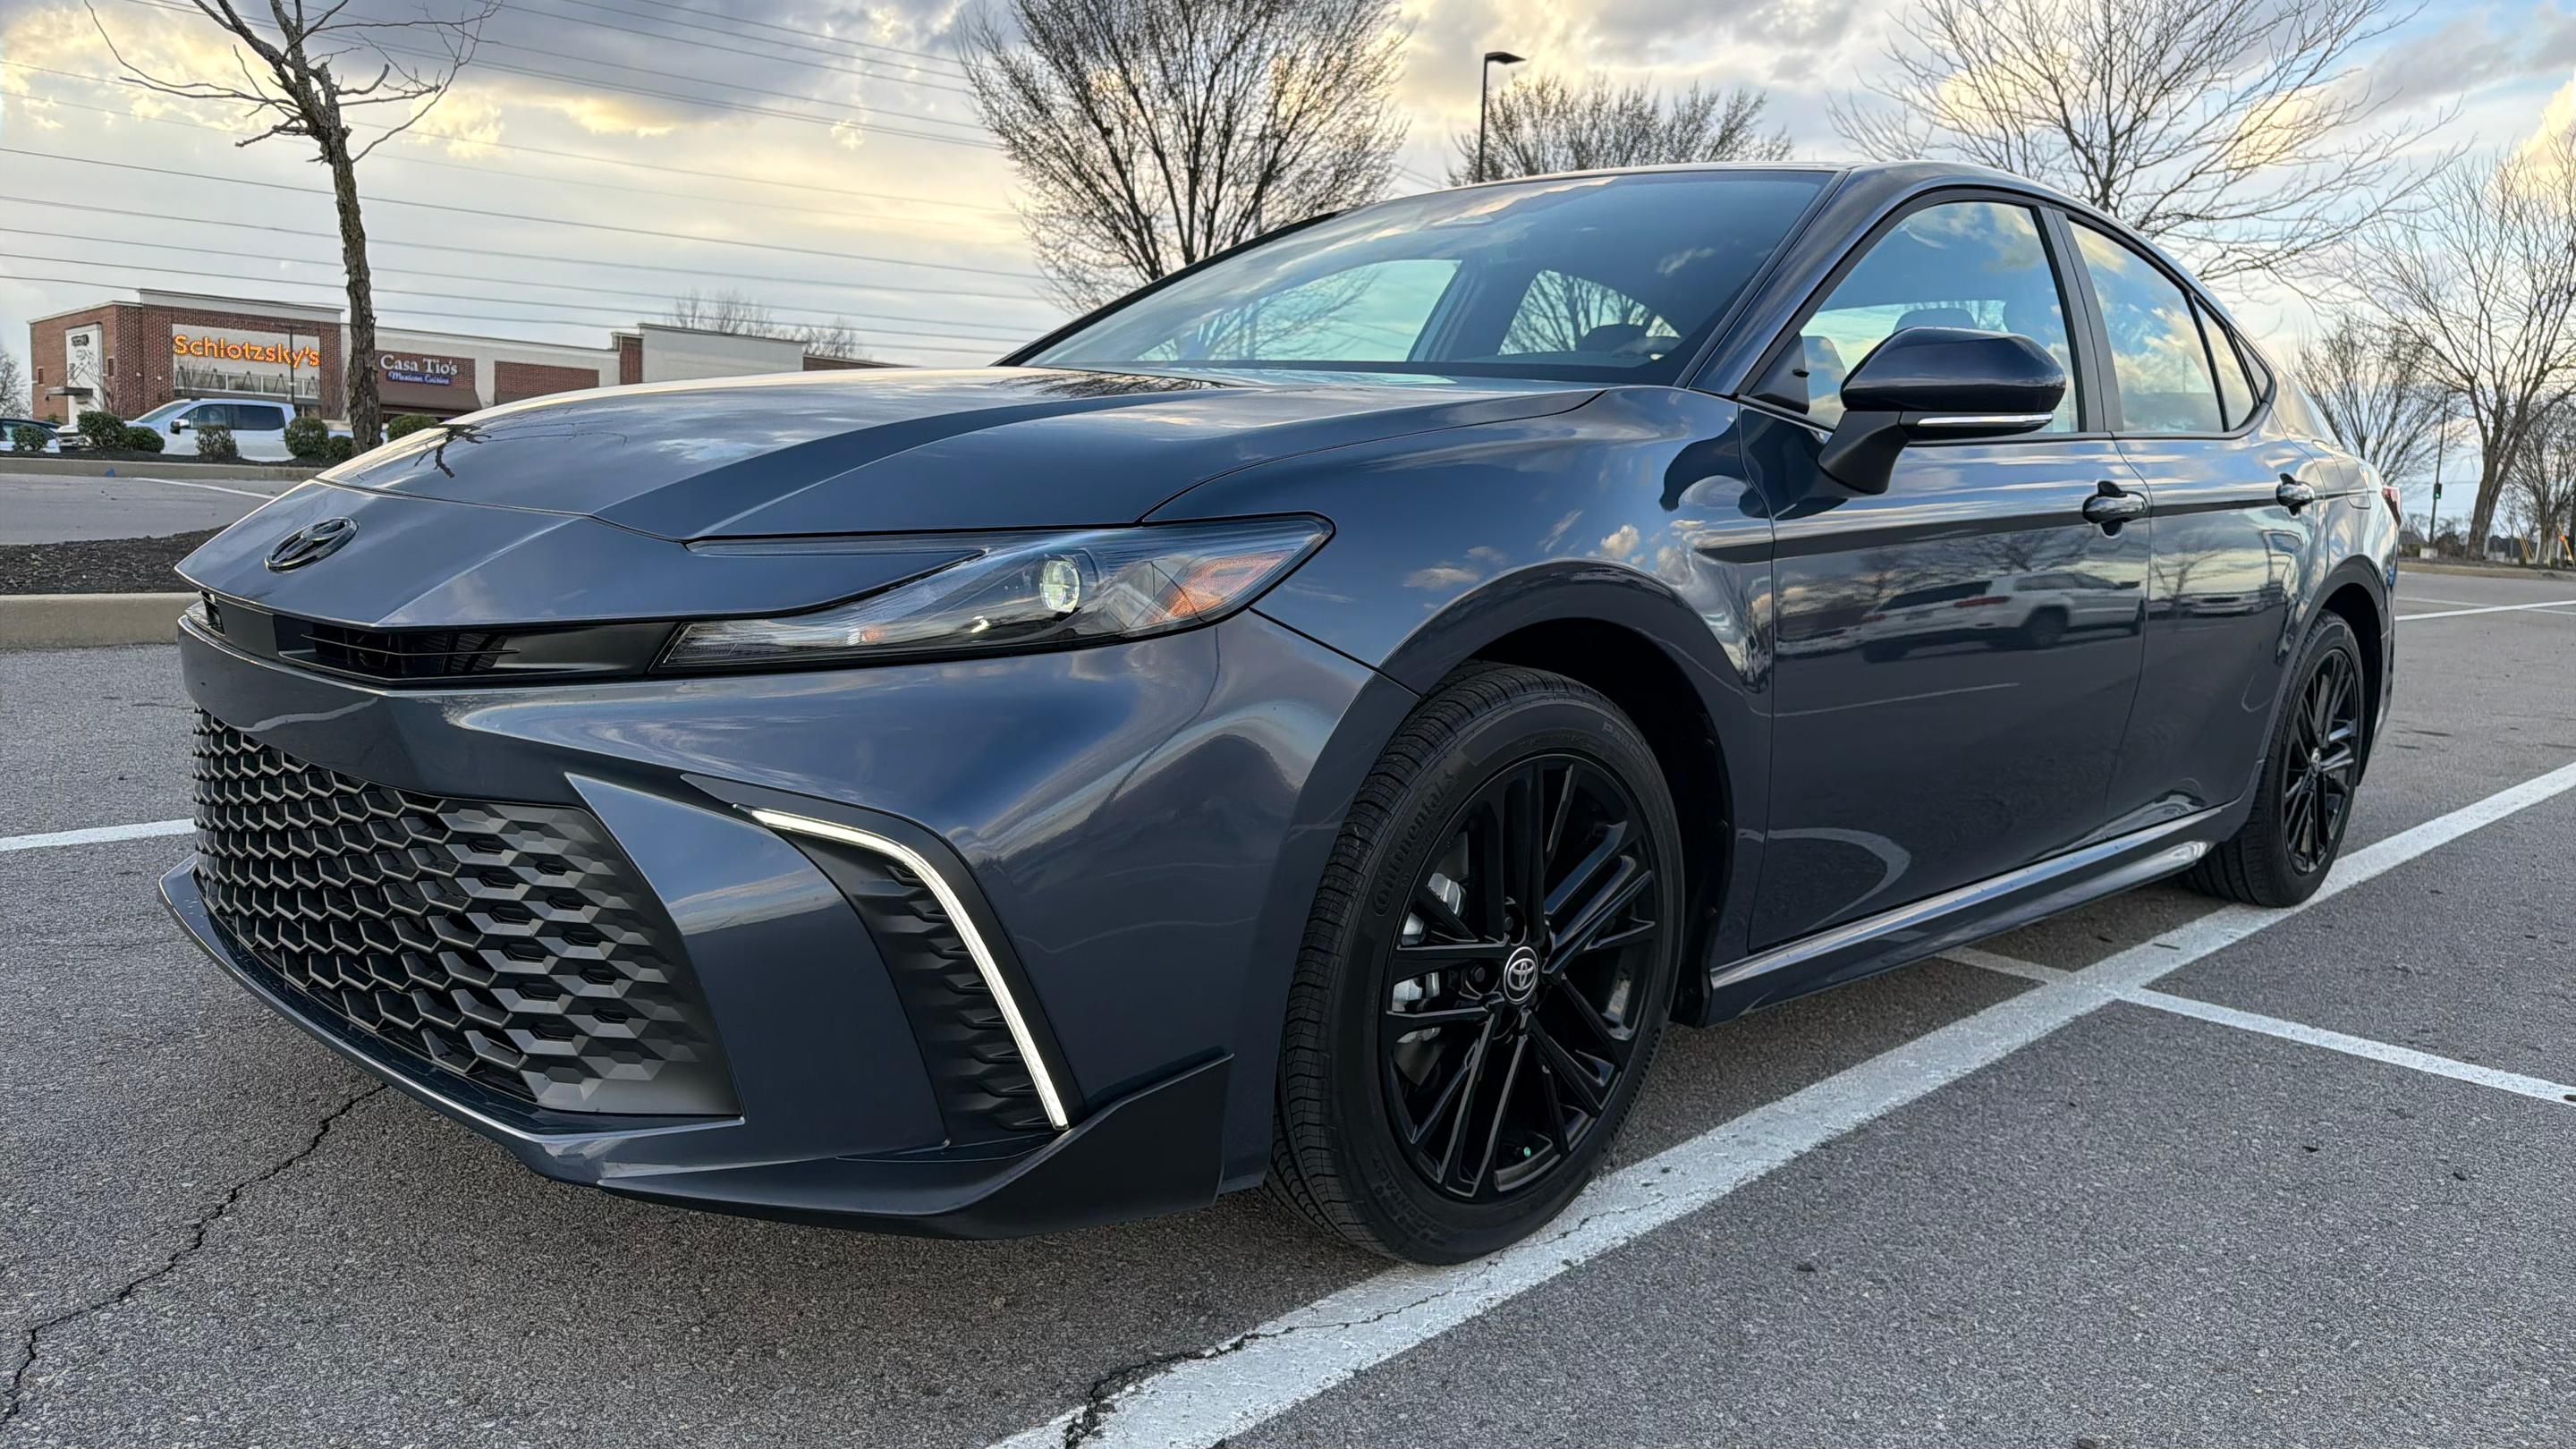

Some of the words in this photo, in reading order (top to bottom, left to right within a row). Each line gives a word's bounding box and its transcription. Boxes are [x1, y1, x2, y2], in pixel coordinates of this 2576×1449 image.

[174, 335, 319, 369] Schlotzsky's
[380, 354, 419, 370] Casa
[422, 358, 458, 375] Tio's
